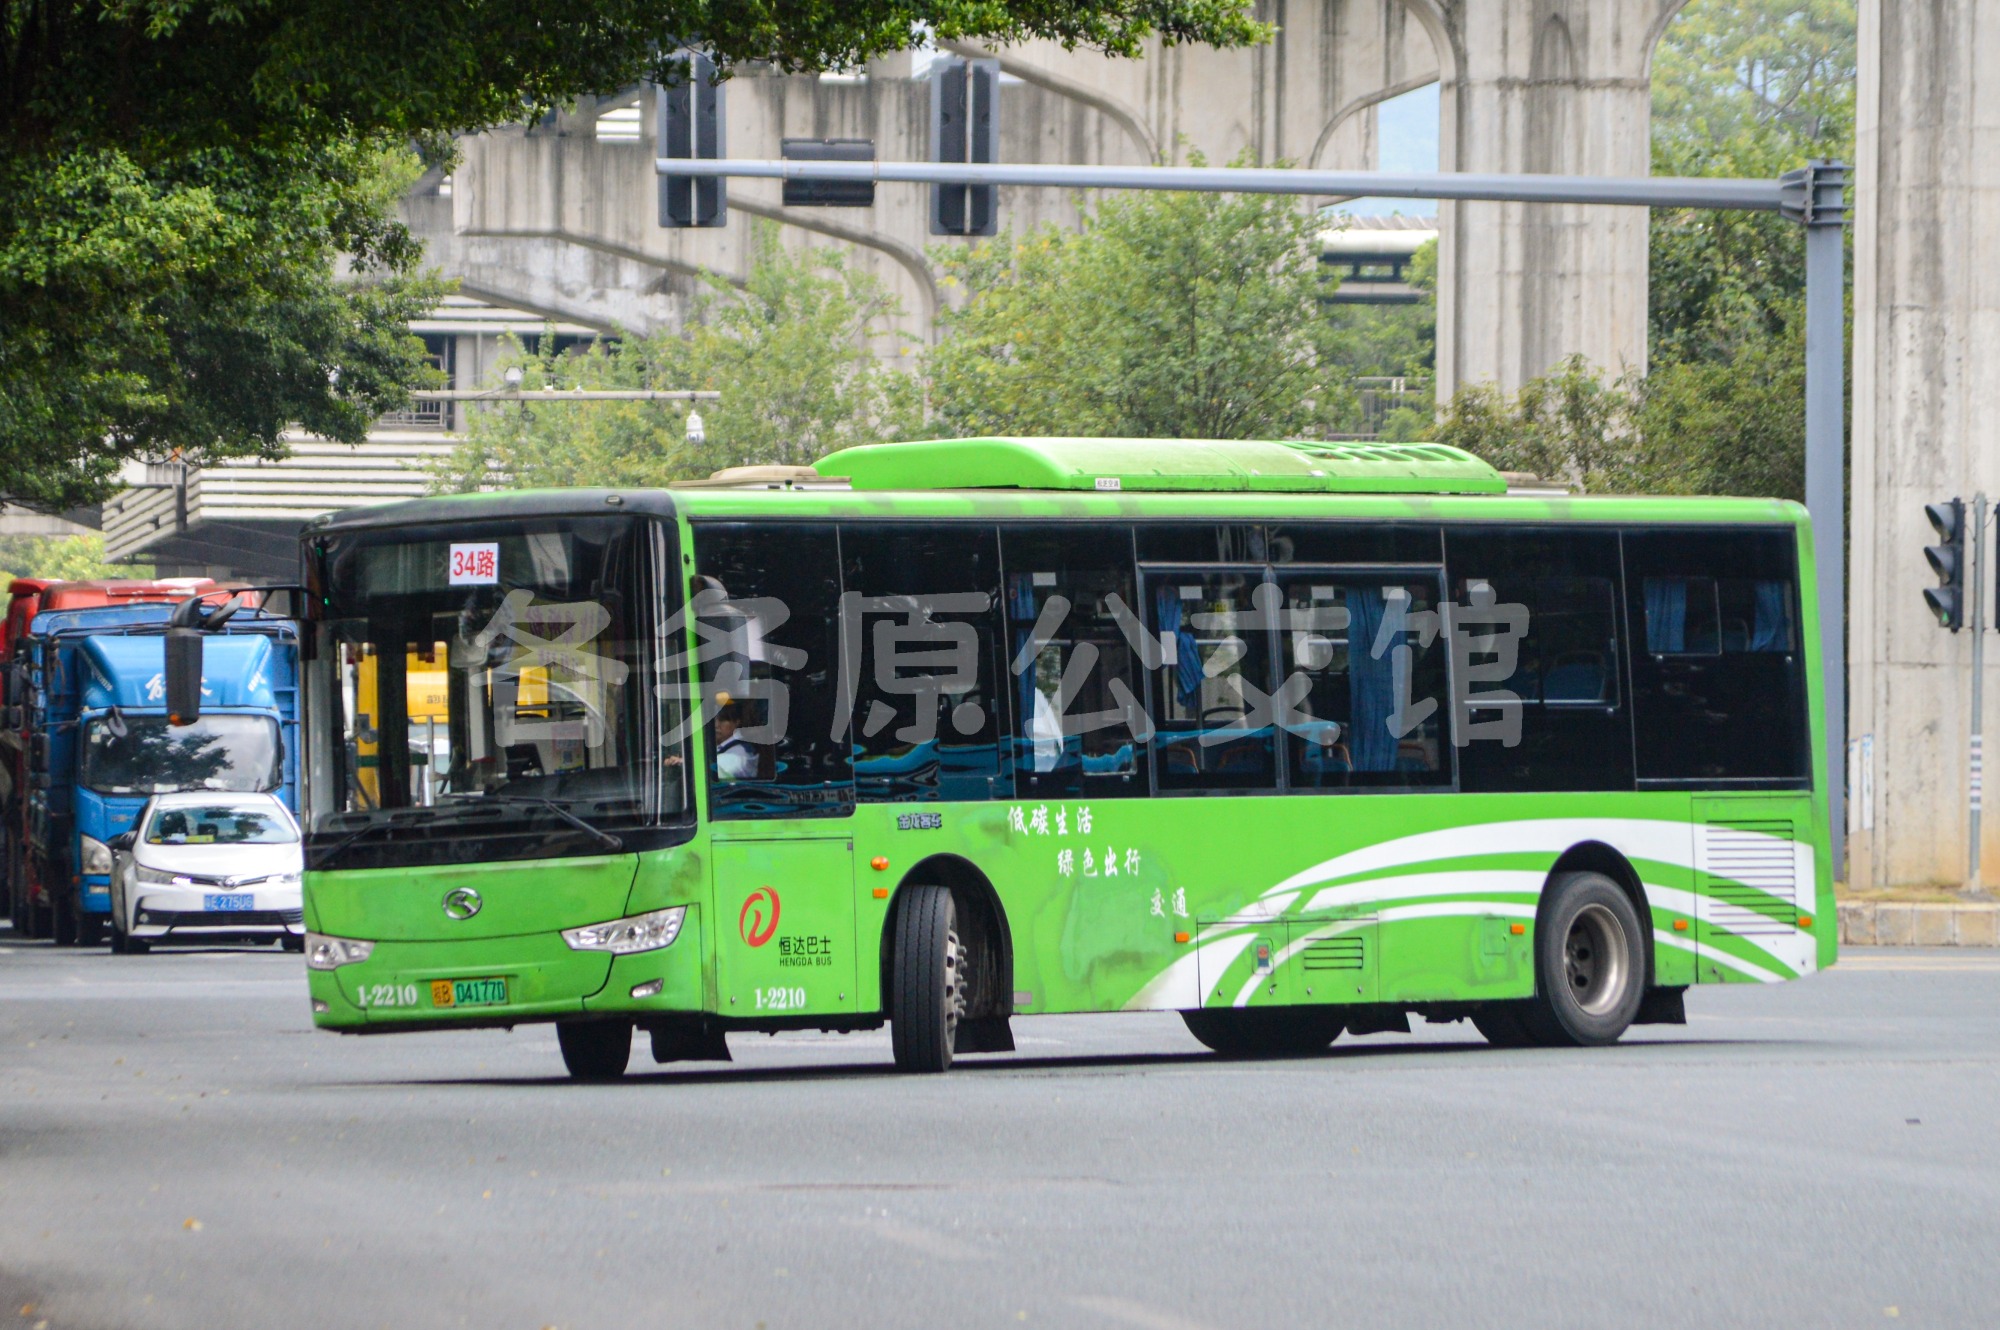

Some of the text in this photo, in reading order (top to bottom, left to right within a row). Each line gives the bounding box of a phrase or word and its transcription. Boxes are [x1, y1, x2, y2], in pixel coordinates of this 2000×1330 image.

[453, 549, 495, 577] 34路
[897, 813, 942, 830] 金龙客车
[1007, 804, 1093, 836] 低碳生活
[1057, 846, 1141, 878] 绿色出行
[1150, 887, 1189, 918] 交通
[779, 936, 831, 956] 恒达巴士
[779, 957, 832, 967] HENGDA BUS
[357, 983, 418, 1007] 1-2210
[755, 986, 806, 1010] 1-2210
